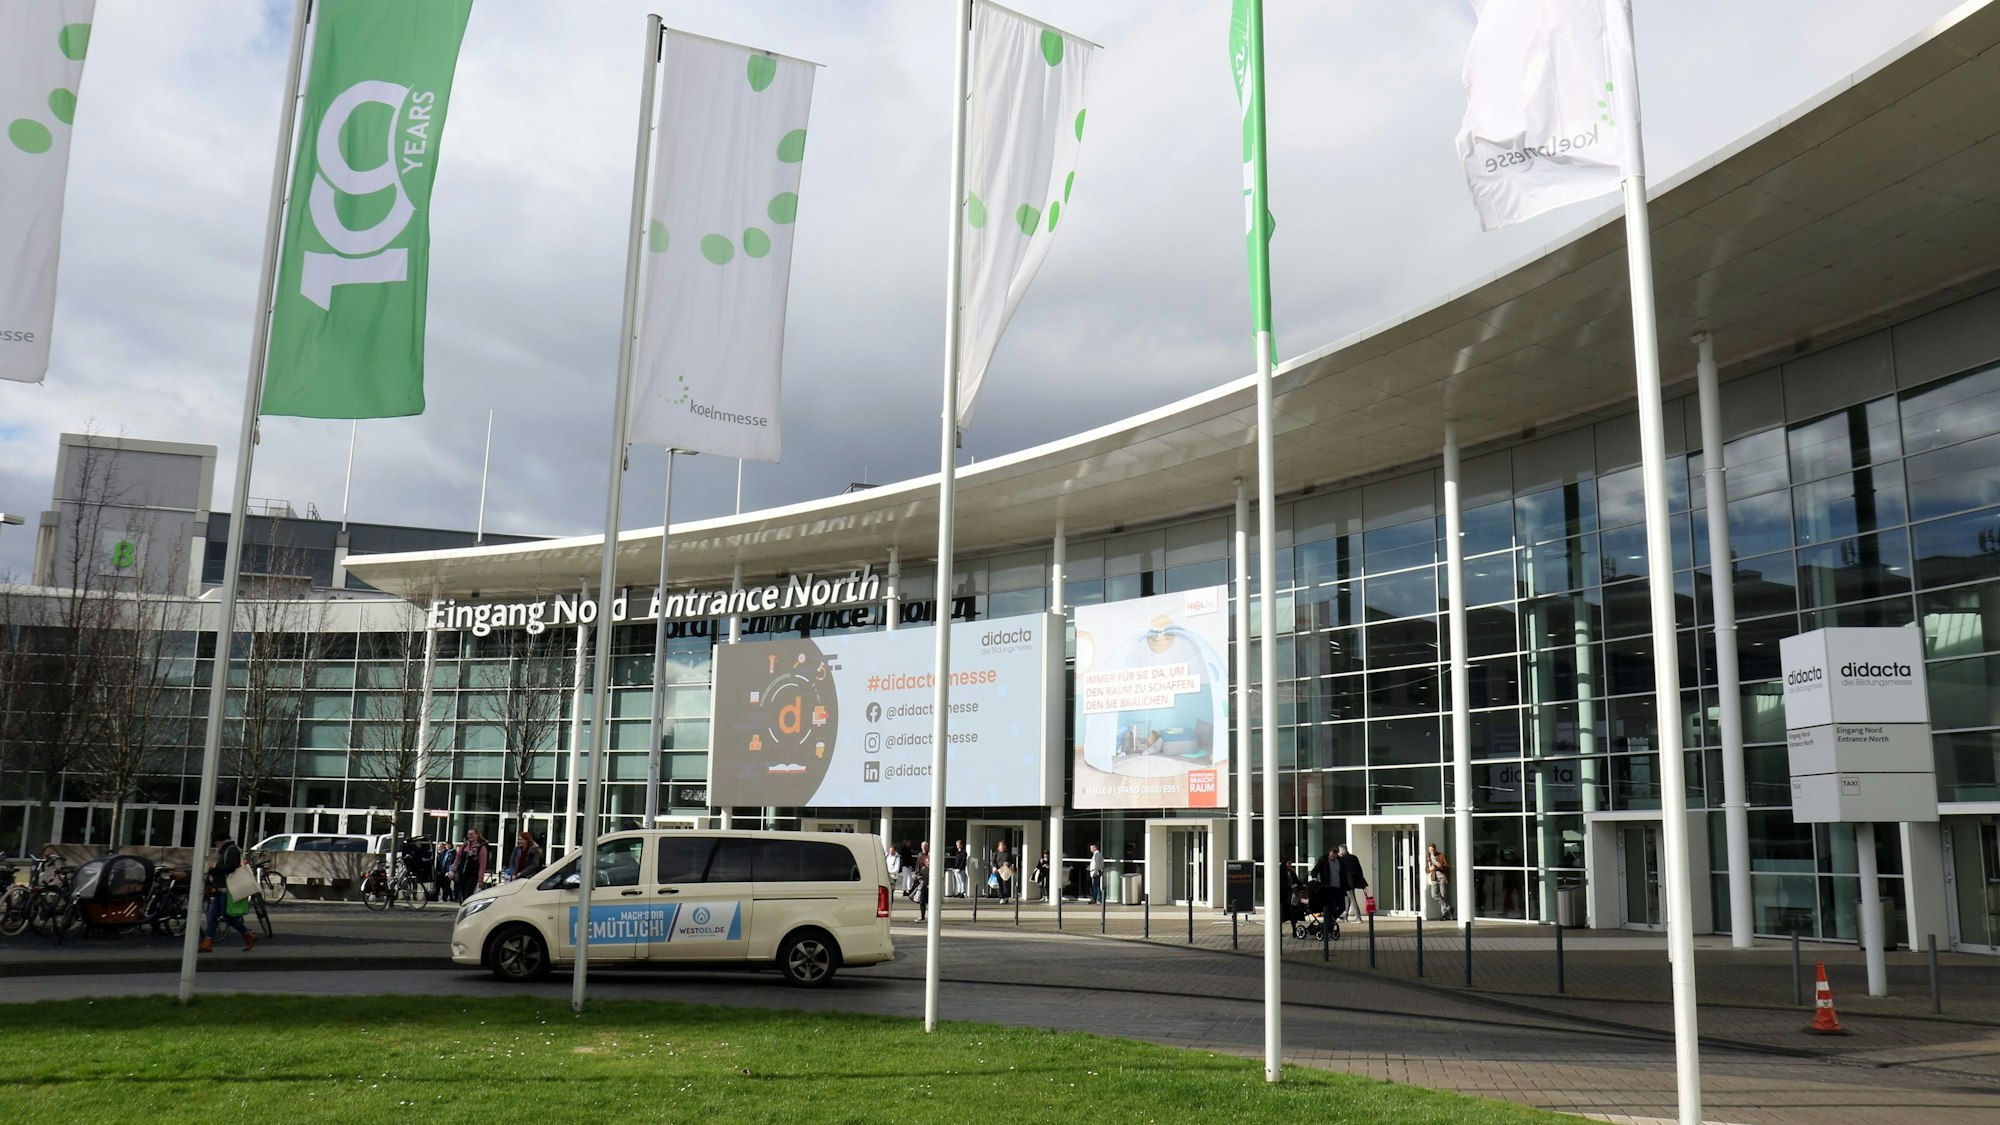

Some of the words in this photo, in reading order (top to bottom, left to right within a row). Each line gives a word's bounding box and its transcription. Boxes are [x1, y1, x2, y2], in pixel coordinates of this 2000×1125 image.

[402, 90, 435, 175] YEARS
[300, 80, 417, 312] 100
[690, 398, 768, 427] koelnmesse
[112, 540, 134, 568] 8
[431, 598, 547, 638] Eingang
[553, 588, 629, 624] Nod
[649, 584, 780, 619] Entrance
[782, 565, 881, 609] North
[981, 627, 1032, 646] didacta
[1086, 673, 1115, 685] IMMER
[1117, 670, 1135, 682] FÜR
[1136, 670, 1149, 681] SIE
[1169, 666, 1185, 677] UM
[1788, 665, 1823, 686] didacta
[1841, 662, 1912, 677] didacta
[1086, 687, 1104, 697] DEN
[1106, 685, 1132, 696] RAUM
[1134, 683, 1146, 693] ZU
[1856, 678, 1913, 687] Bildungsmesse
[1086, 700, 1104, 711] DEN
[1106, 698, 1118, 709] SIE
[778, 696, 802, 735] d
[1836, 727, 1864, 735] Eingang
[1864, 726, 1883, 734] Nord
[1837, 735, 1868, 743] Entrance
[1868, 735, 1889, 743] North
[1189, 783, 1215, 793] RAUM
[620, 911, 649, 920] MACH'S
[650, 910, 664, 919] DIR
